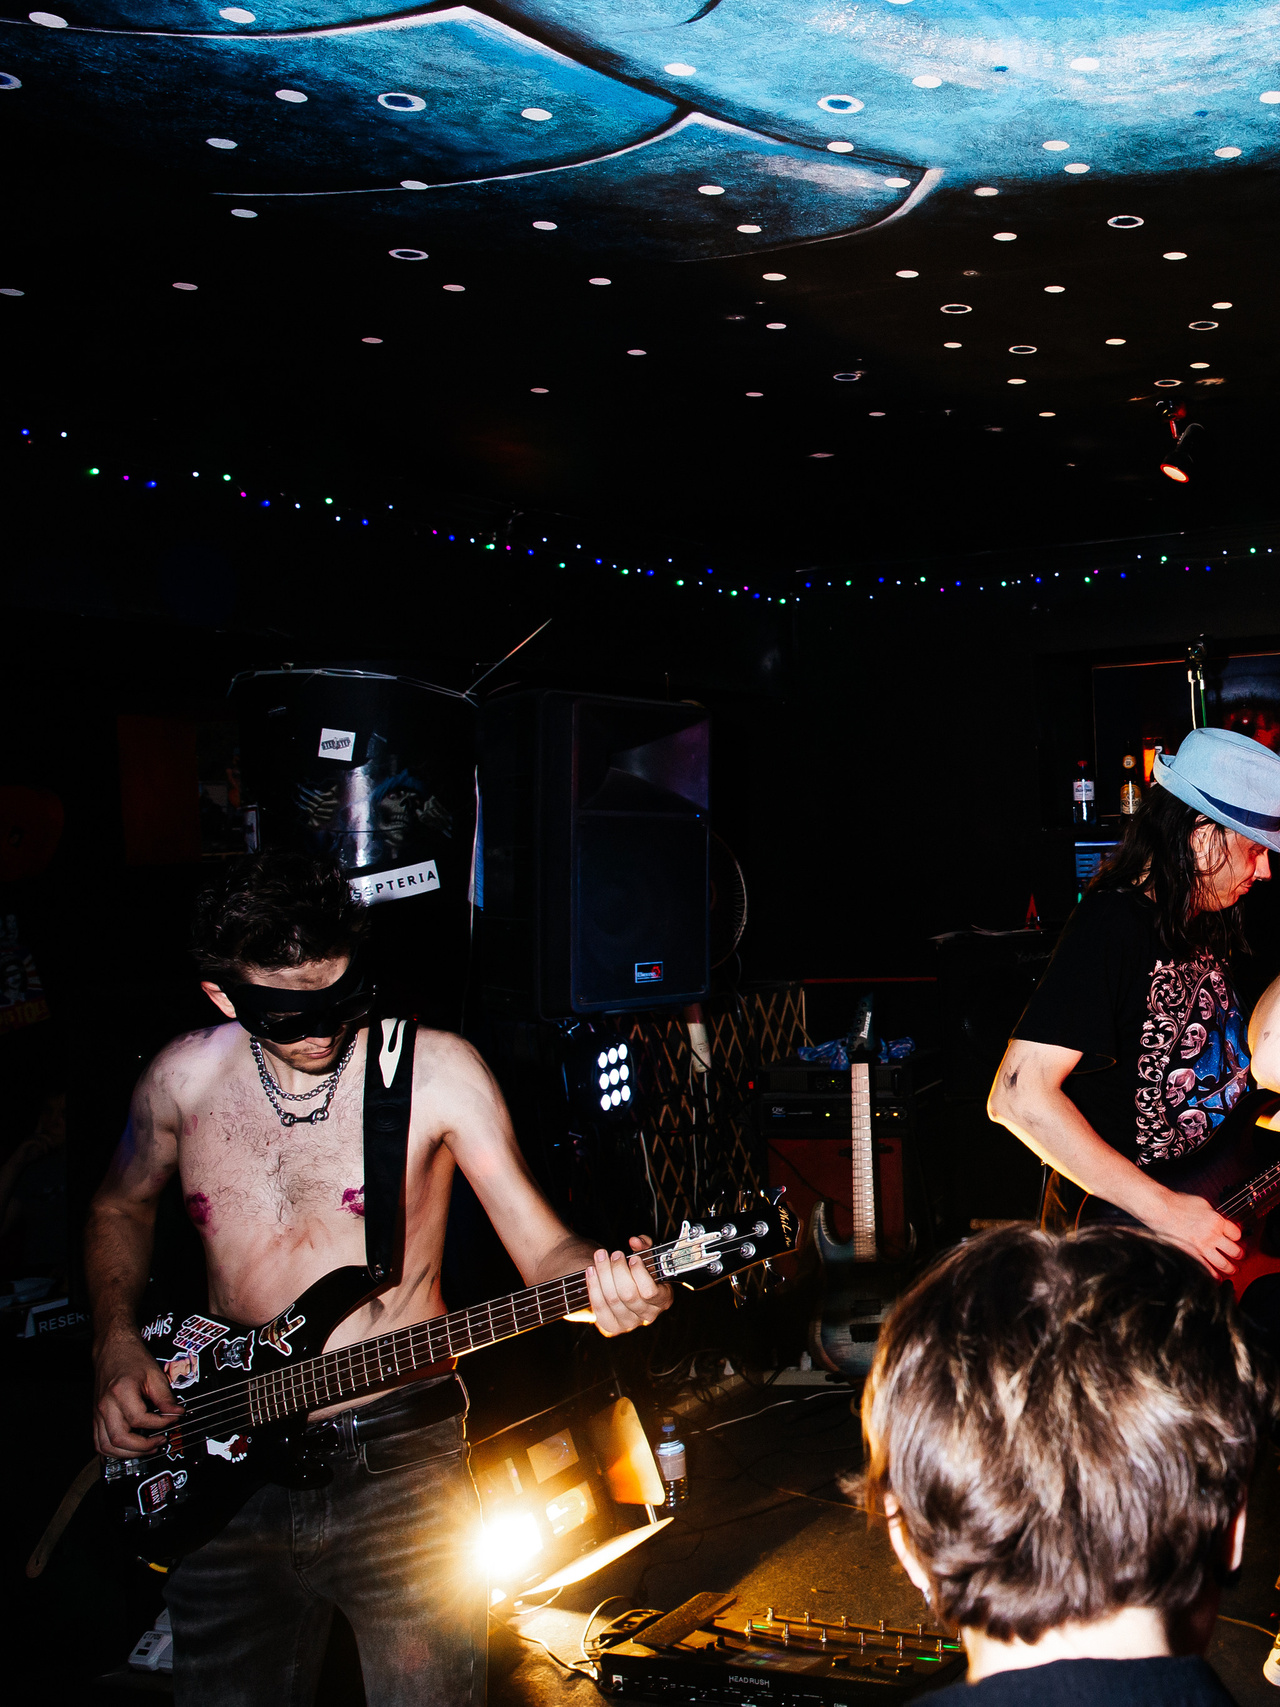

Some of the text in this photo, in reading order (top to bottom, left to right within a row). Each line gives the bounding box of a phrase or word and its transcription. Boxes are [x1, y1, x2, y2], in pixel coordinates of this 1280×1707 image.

[182, 1315, 229, 1338] BANG
[174, 1337, 202, 1351] BANG
[177, 1328, 214, 1345] BANG
[728, 1675, 770, 1689] HEADRUSH
